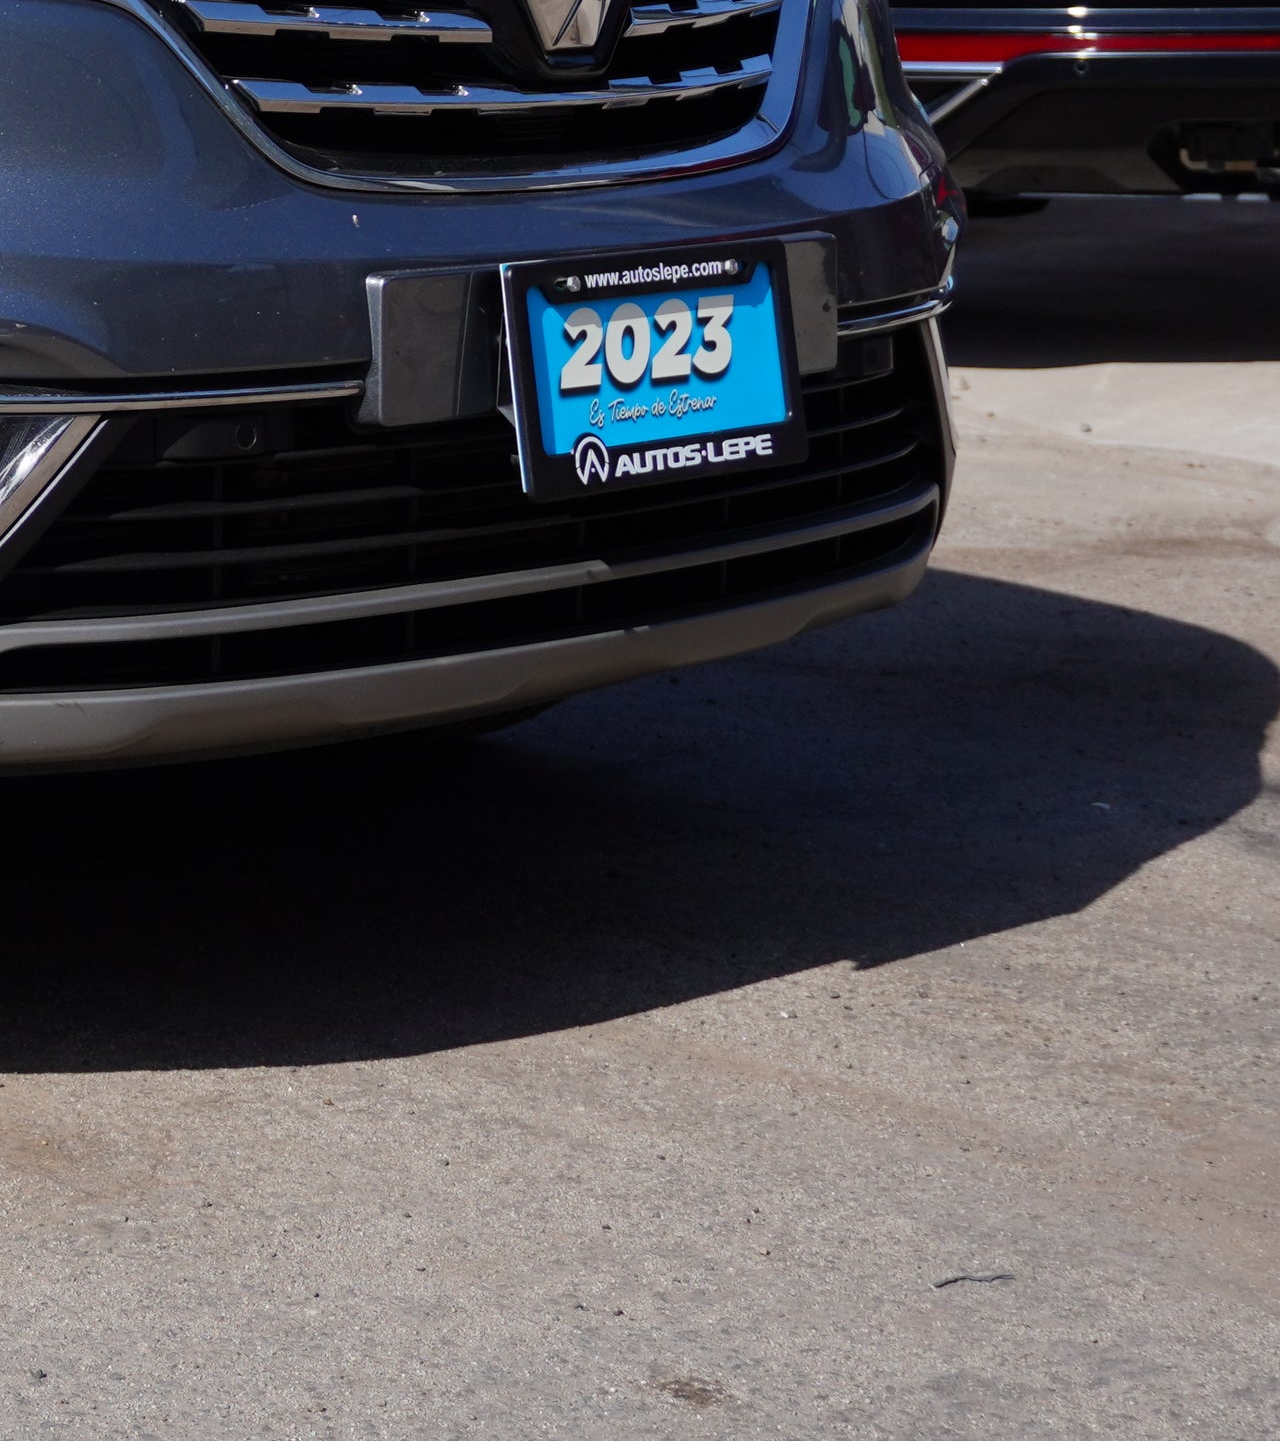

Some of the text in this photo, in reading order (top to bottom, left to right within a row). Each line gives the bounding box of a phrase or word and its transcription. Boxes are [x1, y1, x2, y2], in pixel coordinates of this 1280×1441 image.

[584, 260, 723, 289] www.autoslepe.com
[559, 293, 735, 391] 2023
[589, 398, 605, 427] Es
[608, 397, 649, 422] Tiempo
[651, 396, 666, 416] de
